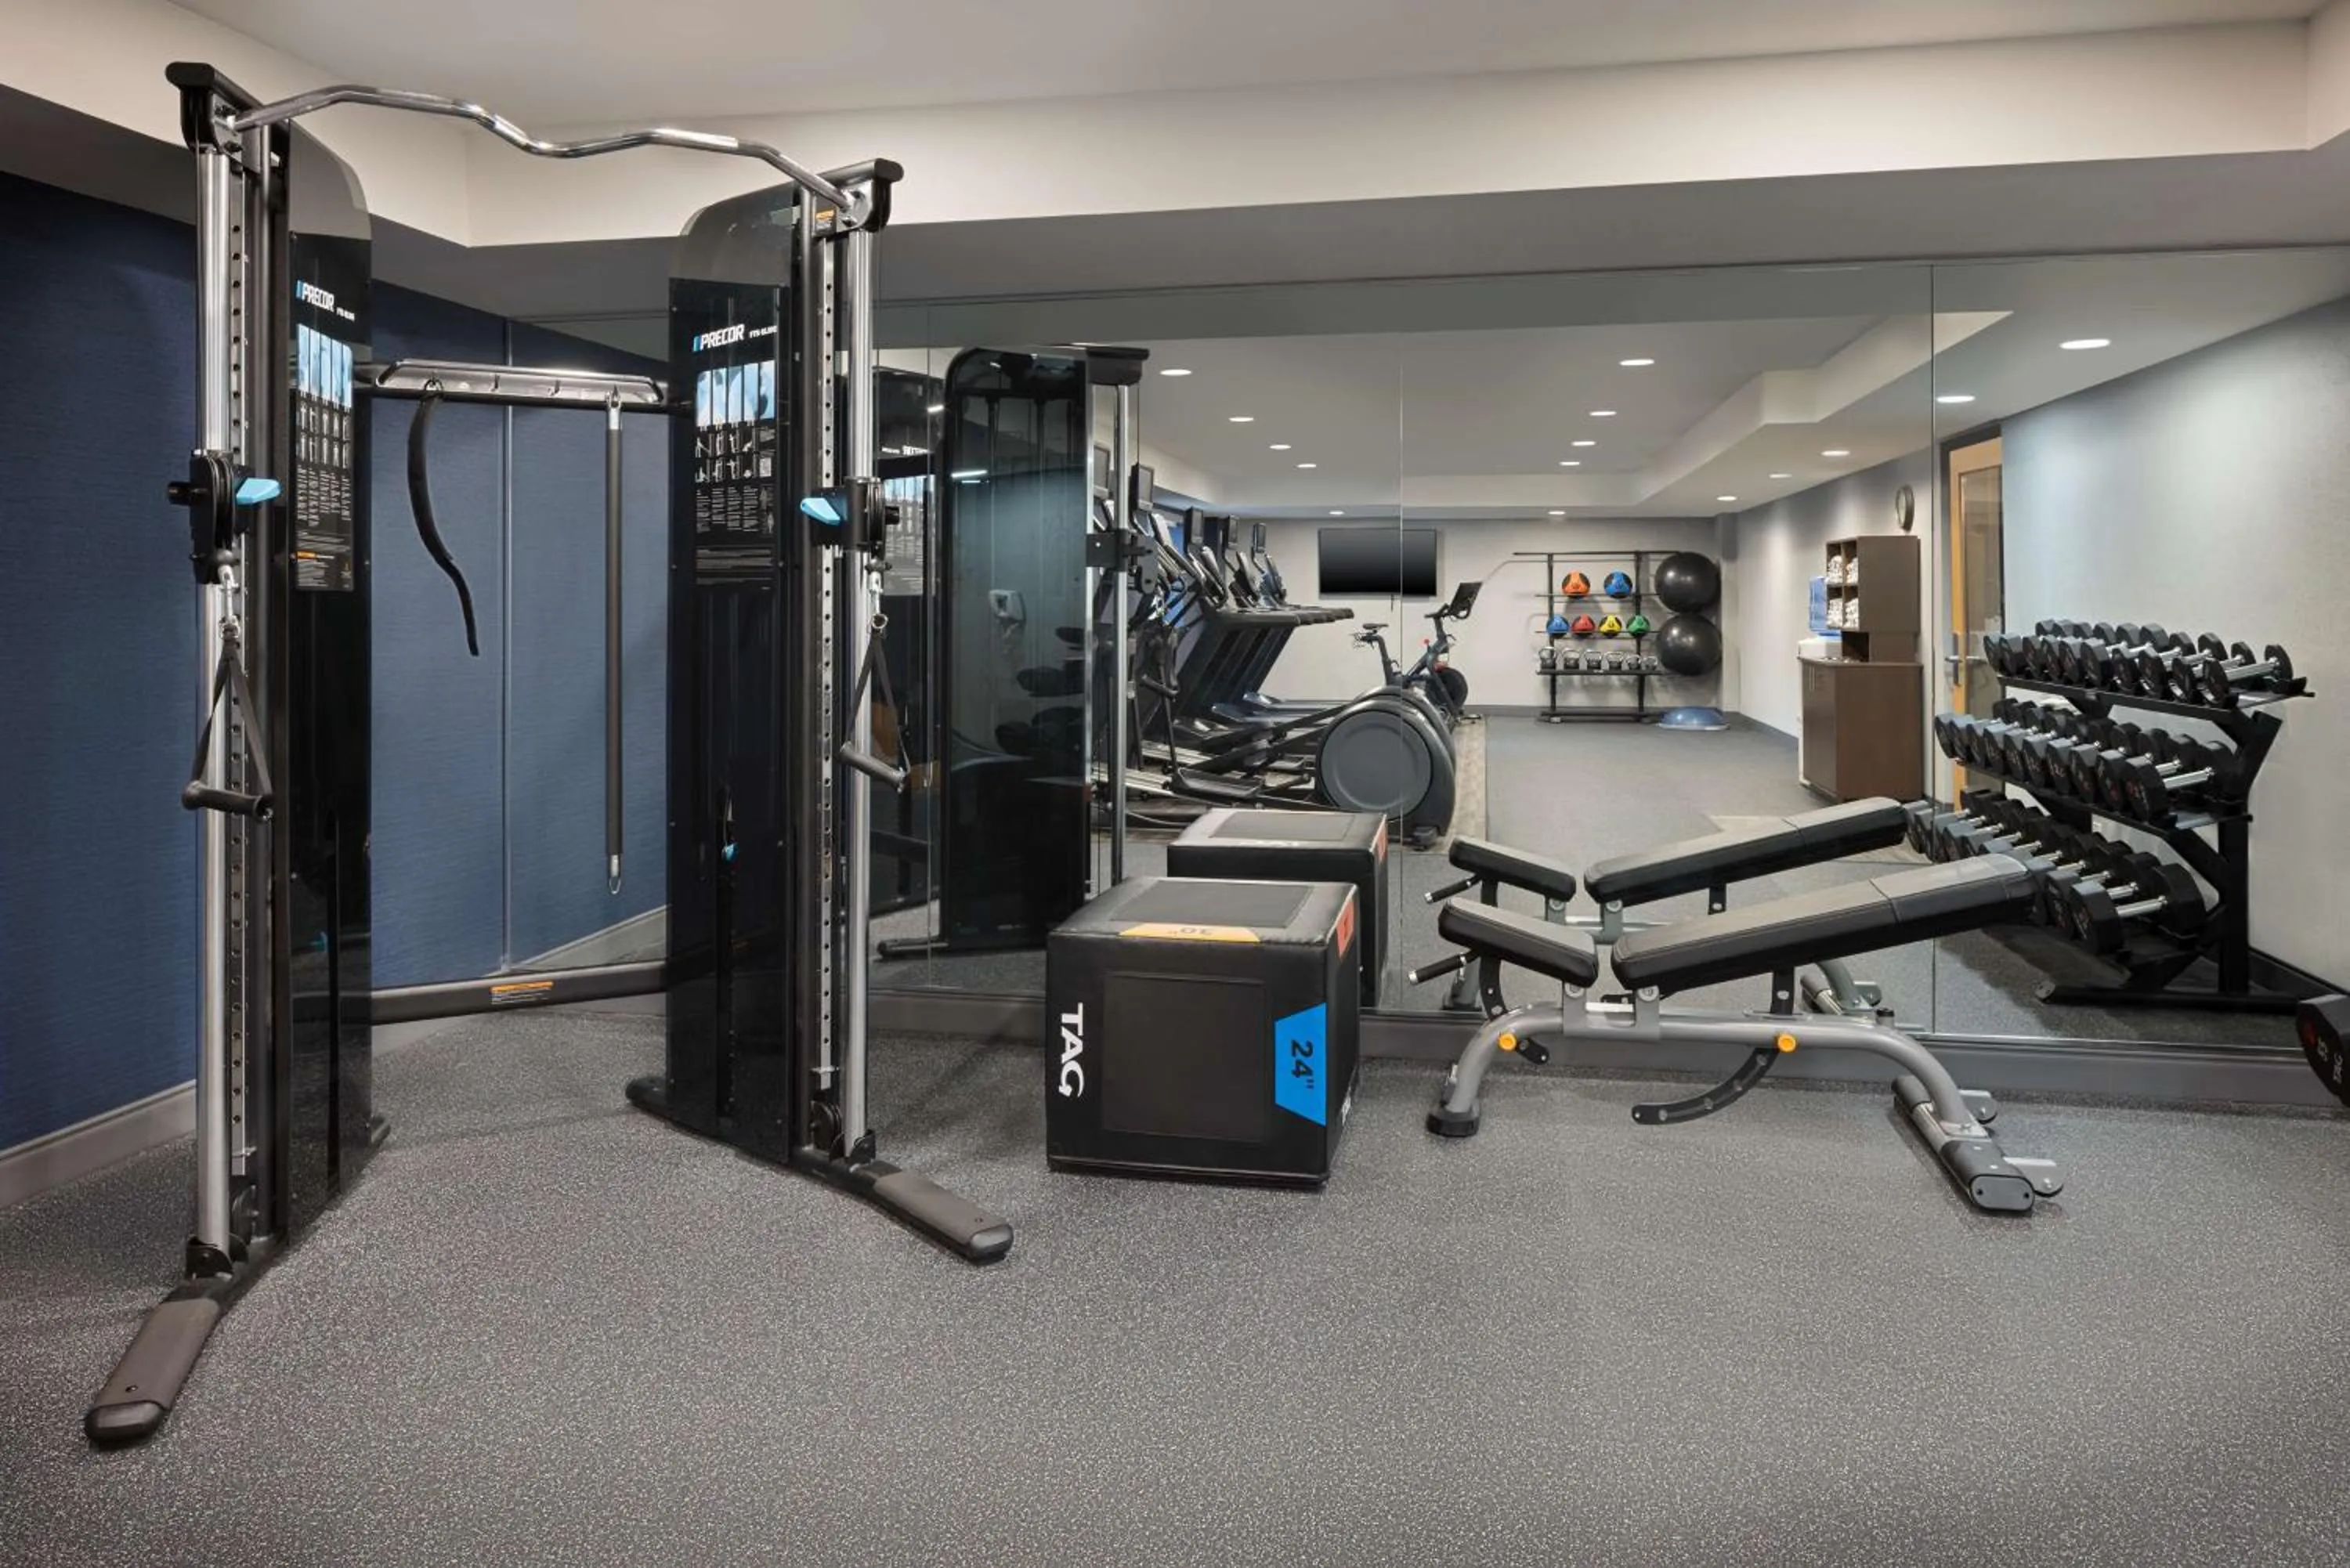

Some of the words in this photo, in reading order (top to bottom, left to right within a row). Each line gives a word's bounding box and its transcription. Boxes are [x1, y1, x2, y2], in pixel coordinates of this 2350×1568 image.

[700, 323, 745, 350] PRECOR
[1058, 1002, 1084, 1097] TAG
[1290, 1039, 1315, 1090] 24"
